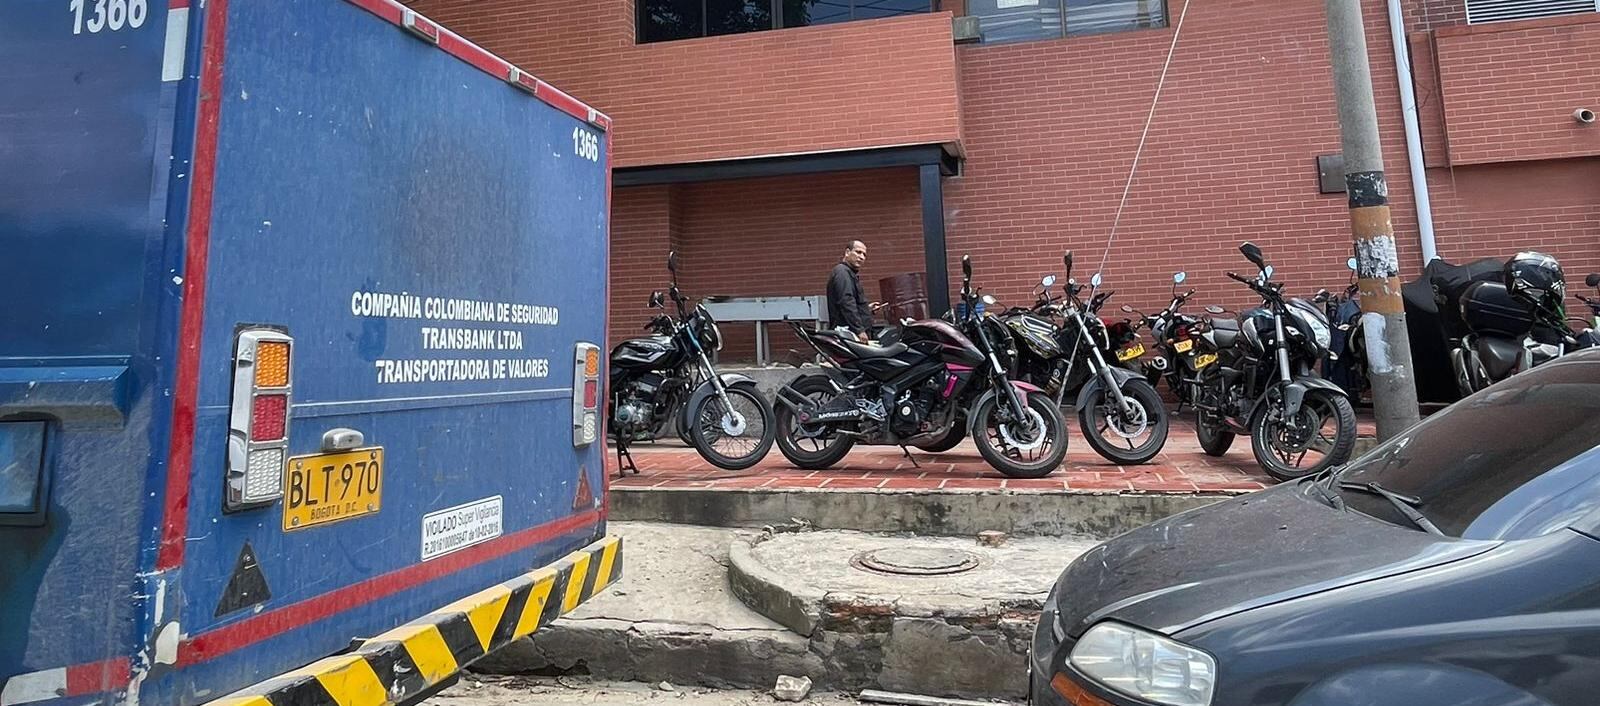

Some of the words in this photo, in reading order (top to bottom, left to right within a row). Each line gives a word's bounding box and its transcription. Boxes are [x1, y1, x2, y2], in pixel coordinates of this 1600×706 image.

[70, 0, 147, 34] 1366
[572, 126, 599, 162] 1366
[351, 291, 422, 318] COMPAÑIA
[425, 297, 495, 322] COLOMBIANA
[497, 302, 510, 323] DE
[511, 303, 559, 325] SEGURIDAD
[421, 327, 495, 350] TRANSBANK
[497, 330, 523, 350] LTDA
[375, 359, 490, 383] TRANSPORTADORA
[492, 359, 506, 379] DE
[508, 358, 549, 378] VALORES
[310, 505, 341, 520] BOGOTA
[425, 515, 457, 537] VIGILADO
[458, 511, 474, 527] Super
[474, 502, 499, 523] Vigilancia
